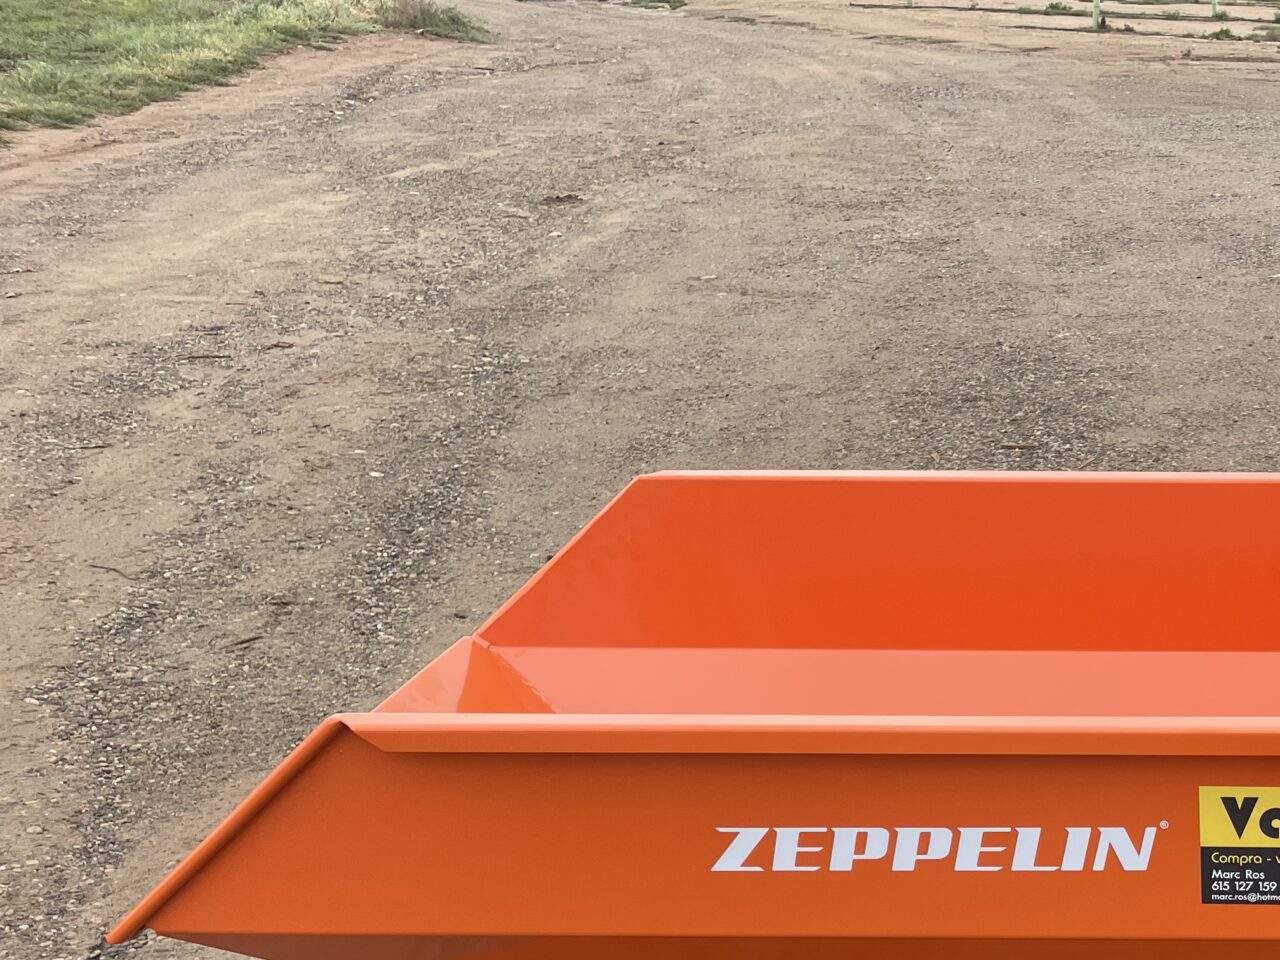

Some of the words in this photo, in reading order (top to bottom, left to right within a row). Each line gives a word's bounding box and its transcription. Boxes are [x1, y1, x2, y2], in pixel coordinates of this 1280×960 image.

[710, 826, 1157, 872] ZEPPELIN
[1211, 852, 1262, 866] Compra
[1211, 869, 1240, 879] Marc
[1245, 869, 1265, 879] Ros
[1211, 881, 1230, 891] 615
[1235, 881, 1253, 891] 127
[1258, 881, 1277, 891] 159
